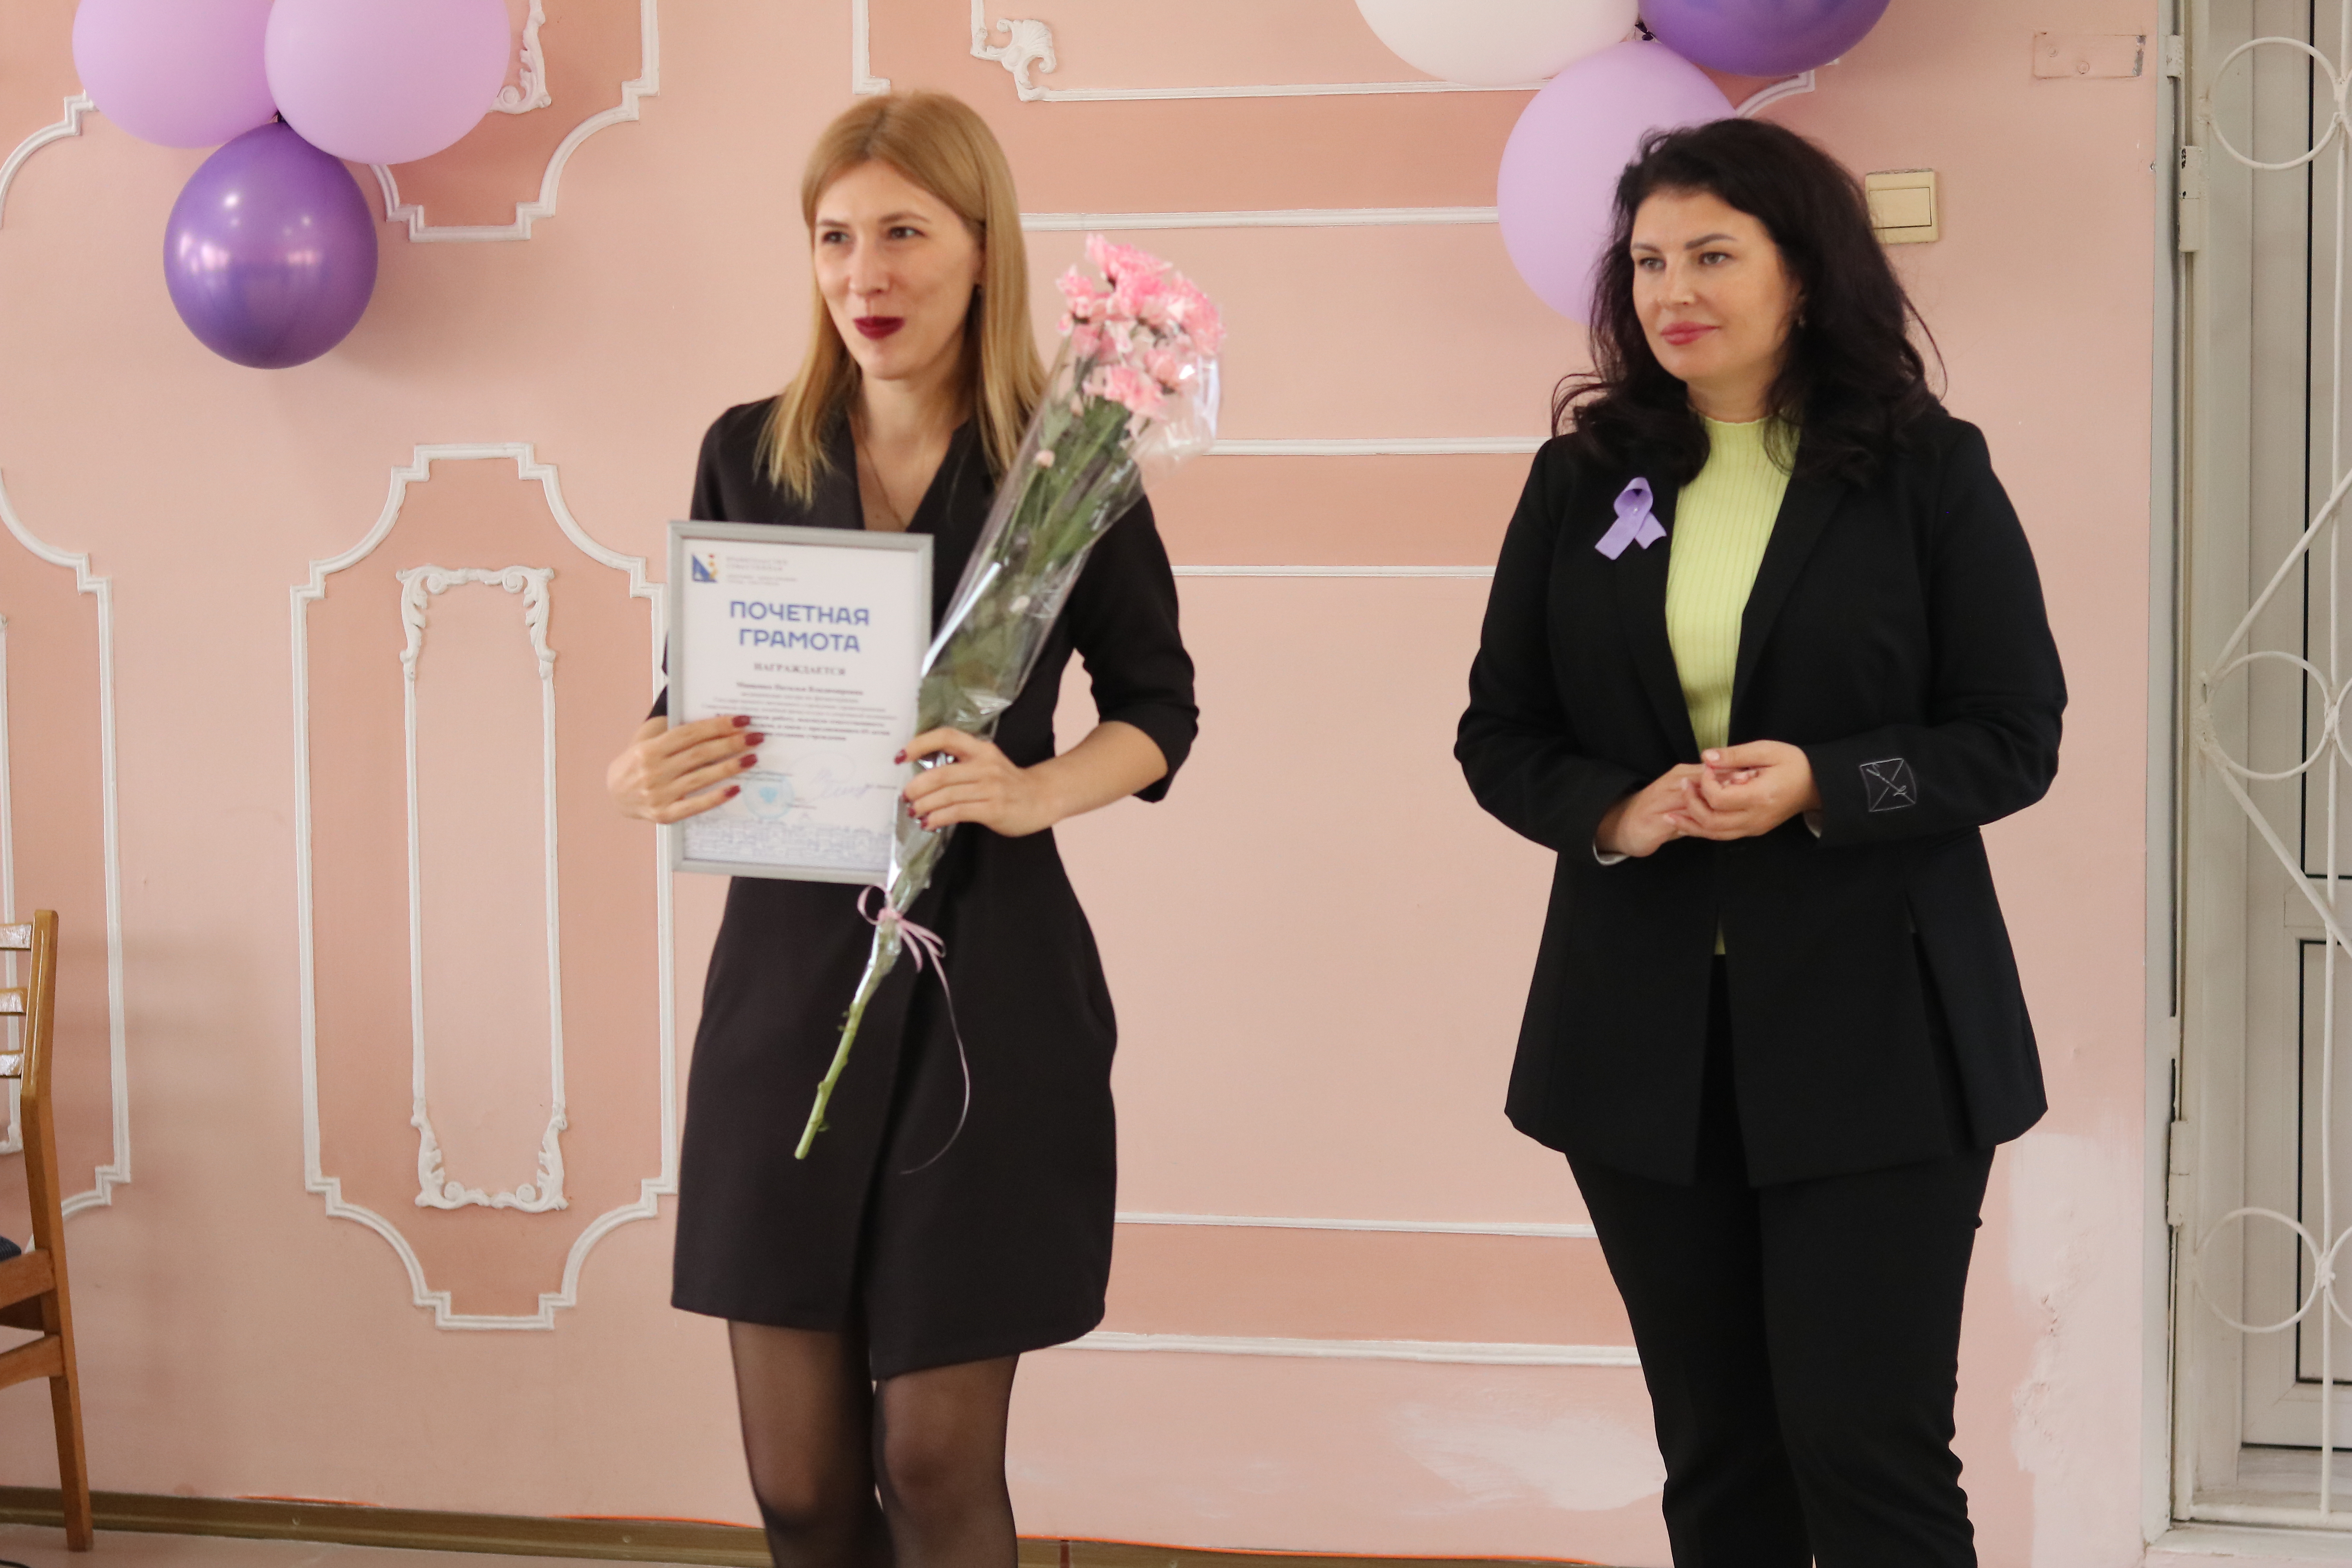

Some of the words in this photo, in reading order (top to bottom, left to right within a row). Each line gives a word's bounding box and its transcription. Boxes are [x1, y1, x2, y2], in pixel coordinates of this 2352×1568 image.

[731, 601, 869, 625] ПОЧЕТНАЯ
[740, 629, 860, 652] ГРАМОТА
[753, 663, 845, 675] НАГРАЖДАЕТСЯ
